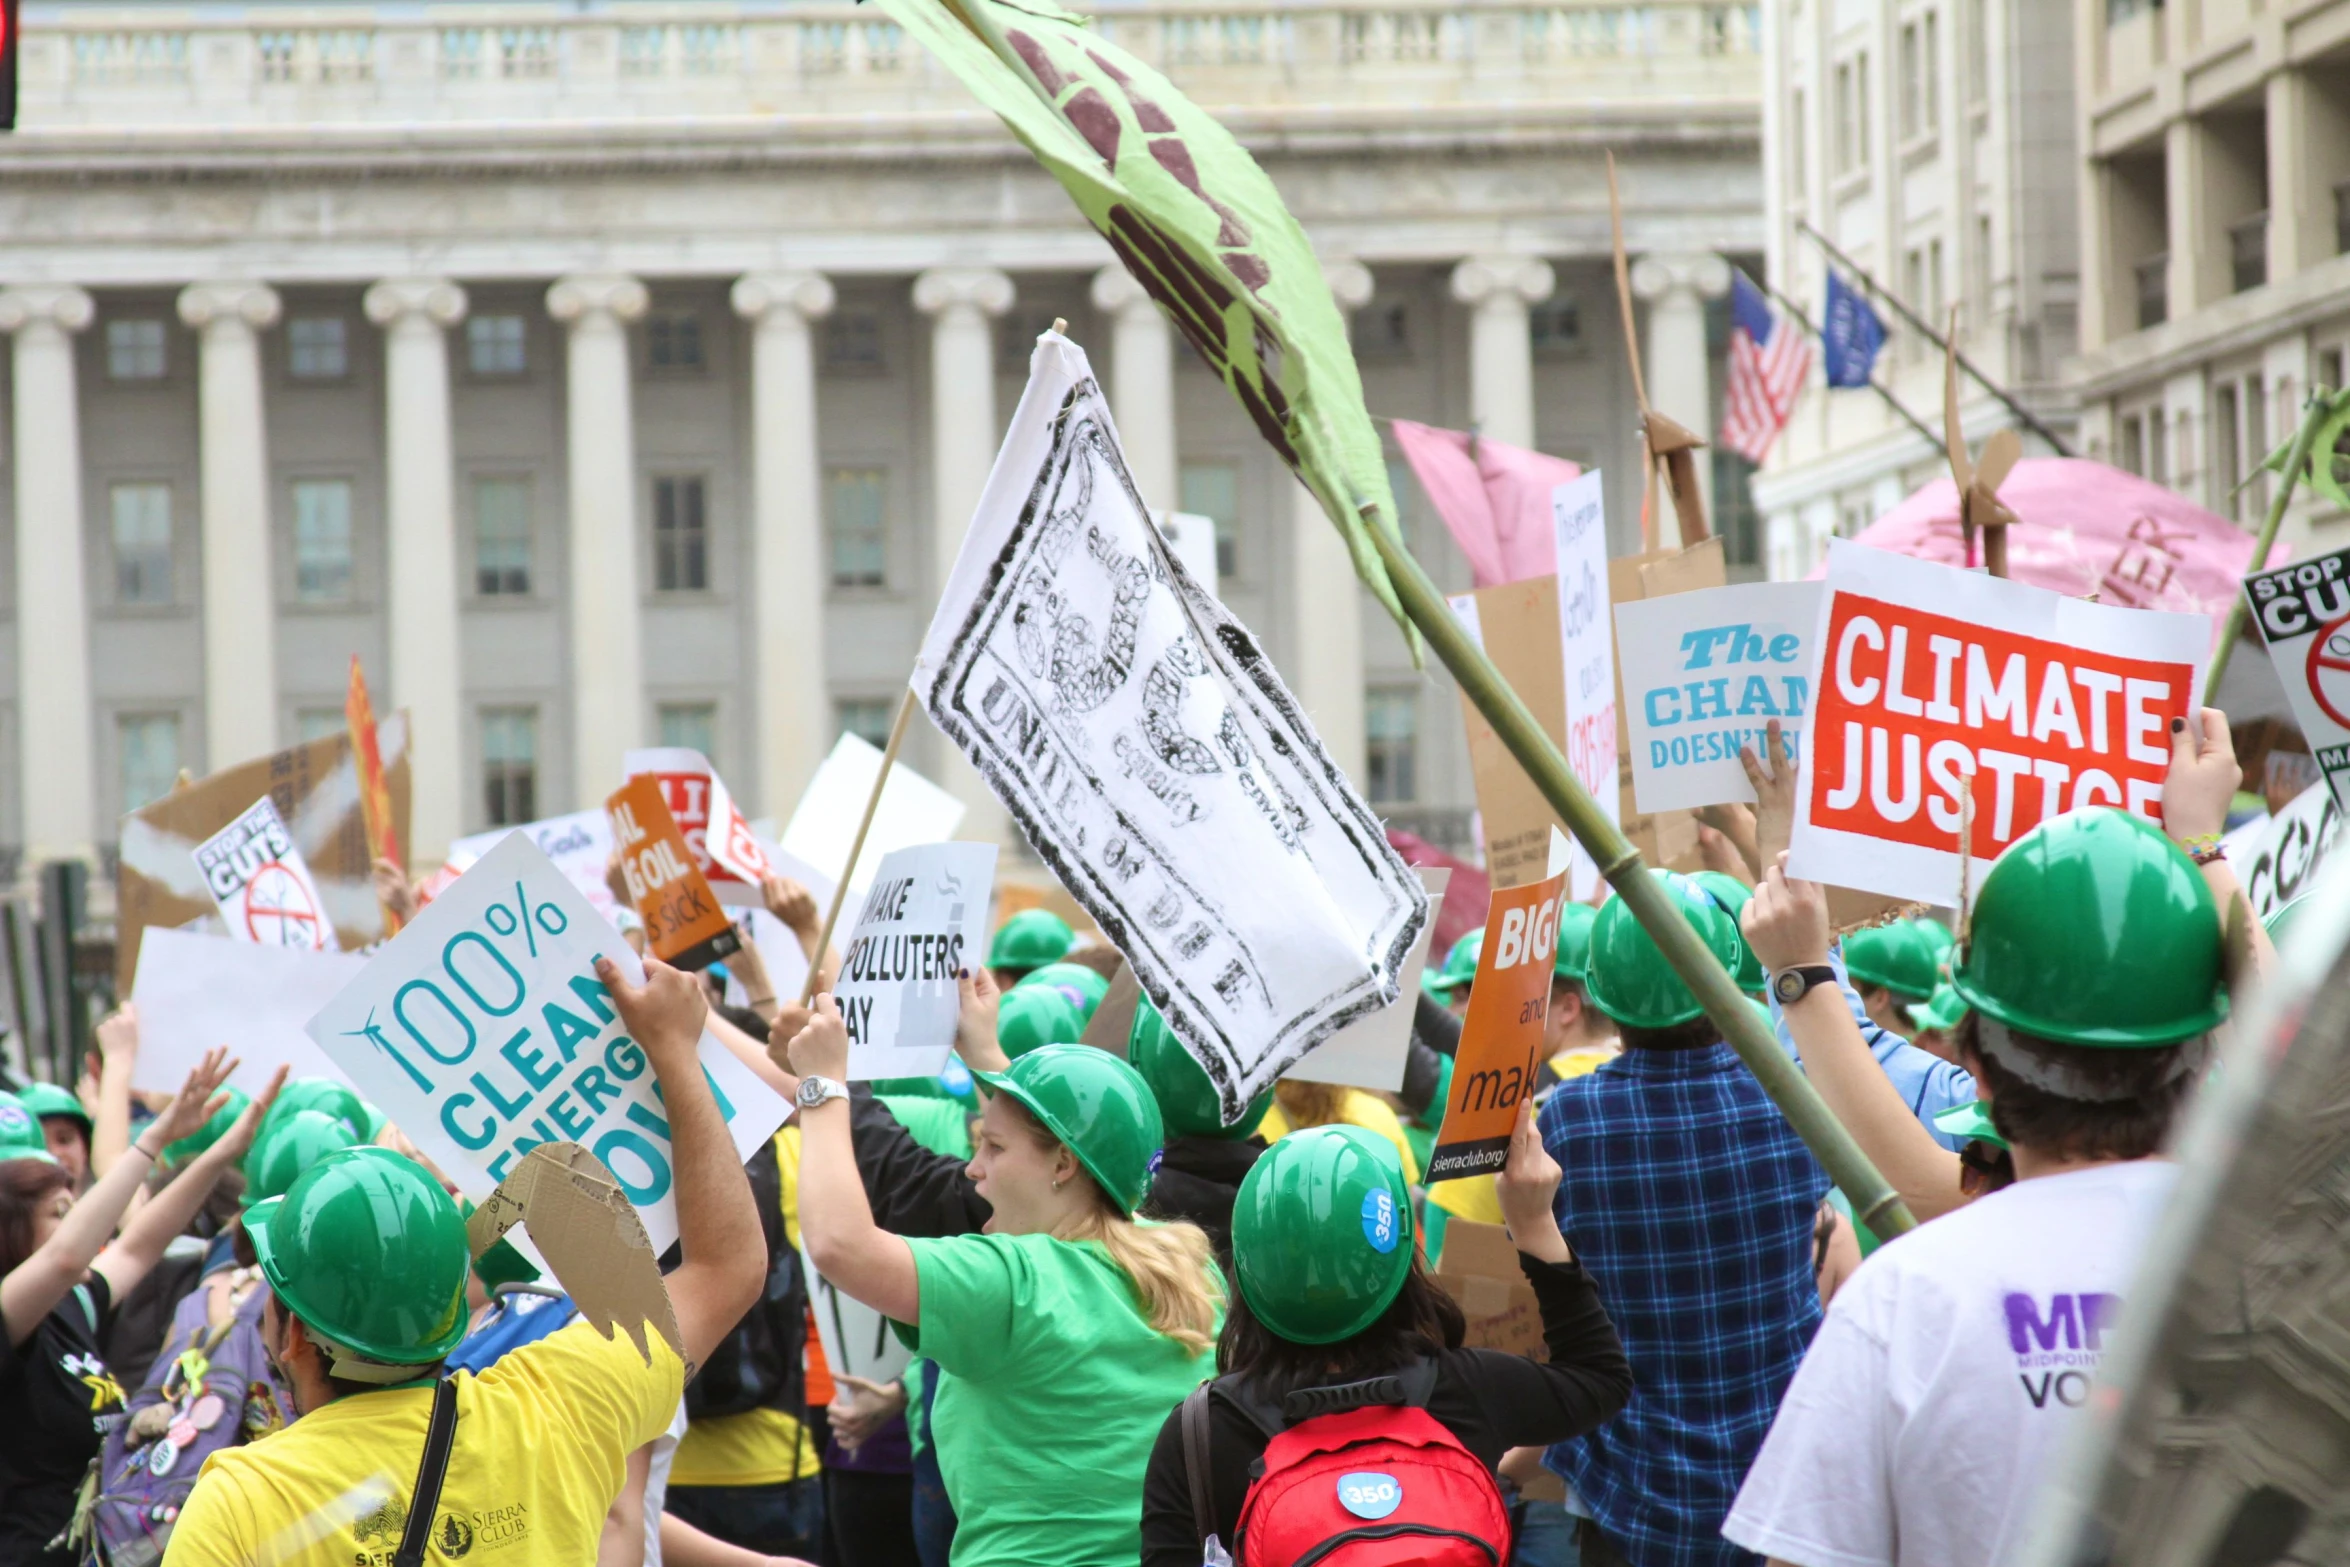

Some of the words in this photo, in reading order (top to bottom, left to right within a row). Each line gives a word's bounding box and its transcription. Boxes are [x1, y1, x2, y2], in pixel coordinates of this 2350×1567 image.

[2254, 556, 2342, 600] STOP
[2263, 576, 2350, 635] CU
[1679, 623, 1800, 671] The
[1836, 615, 2170, 767] CLIMATE
[209, 822, 289, 896] CUTS
[639, 839, 690, 891] OIL
[659, 880, 711, 934] sick
[861, 877, 914, 926] MAKE
[838, 933, 964, 983] POLLUTERS
[1494, 898, 1554, 970] BIG
[342, 881, 568, 1096] 100%
[440, 952, 616, 1151] CLEAN
[486, 1036, 647, 1188] NERG
[1375, 1193, 1393, 1243] 350
[472, 1502, 527, 1530] SIERRA
[1346, 1483, 1395, 1504] 350
[480, 1518, 526, 1544] CLUB
